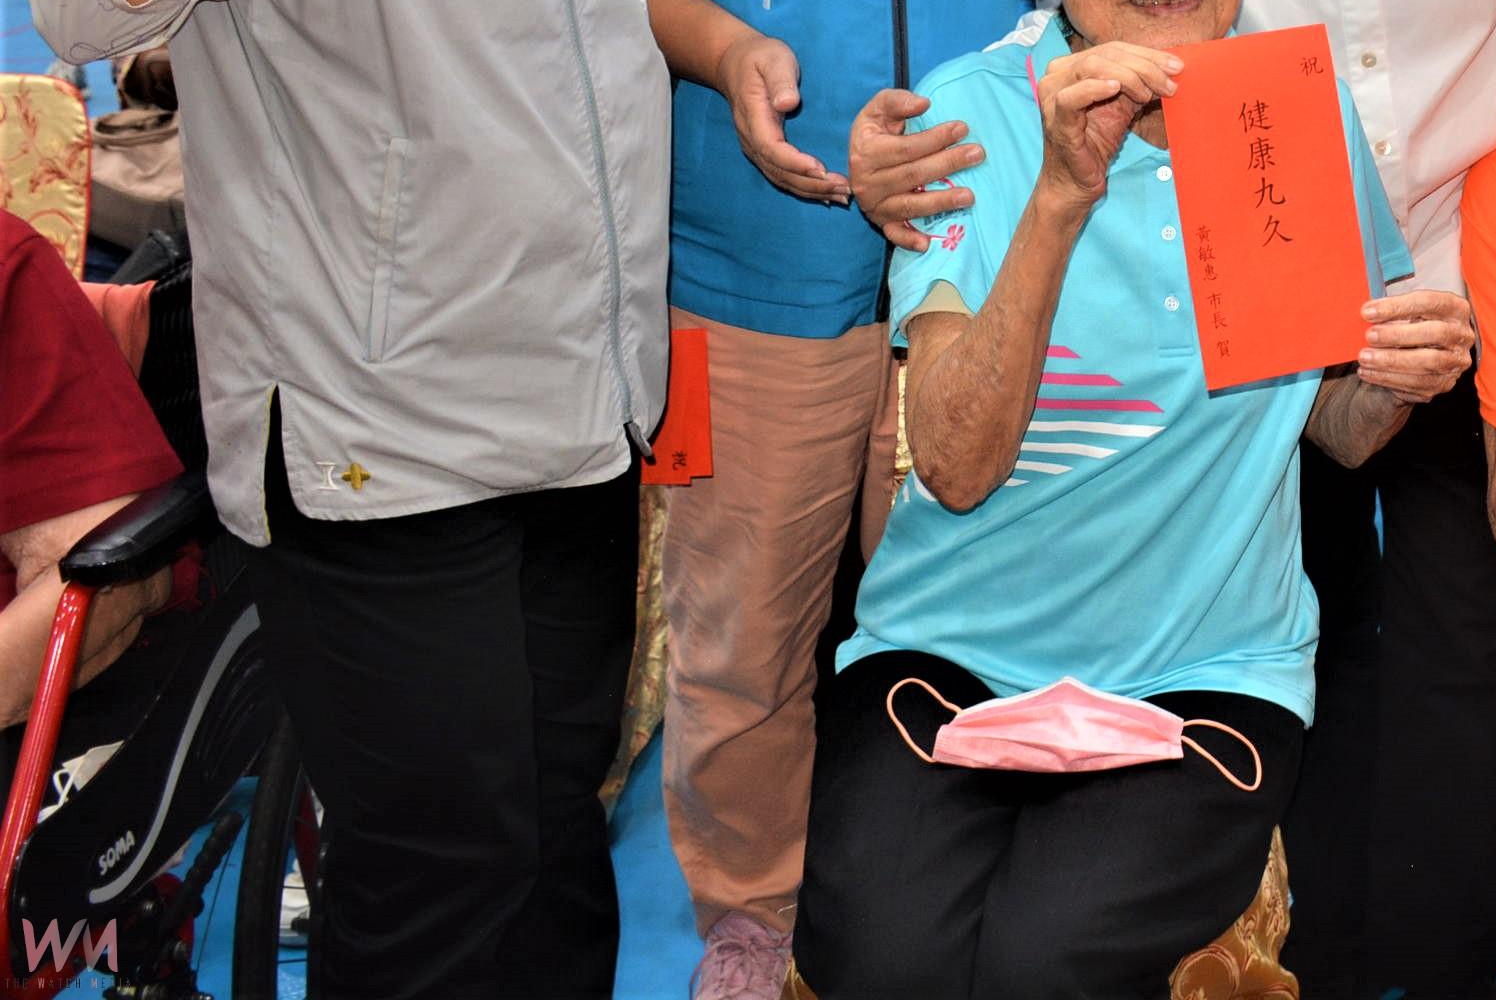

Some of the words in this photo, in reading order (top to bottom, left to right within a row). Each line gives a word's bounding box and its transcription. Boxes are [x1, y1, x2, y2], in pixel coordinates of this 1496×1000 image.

[1299, 55, 1325, 77] 祝
[1238, 100, 1293, 247] 健康九久
[98, 830, 136, 876] SOMA
